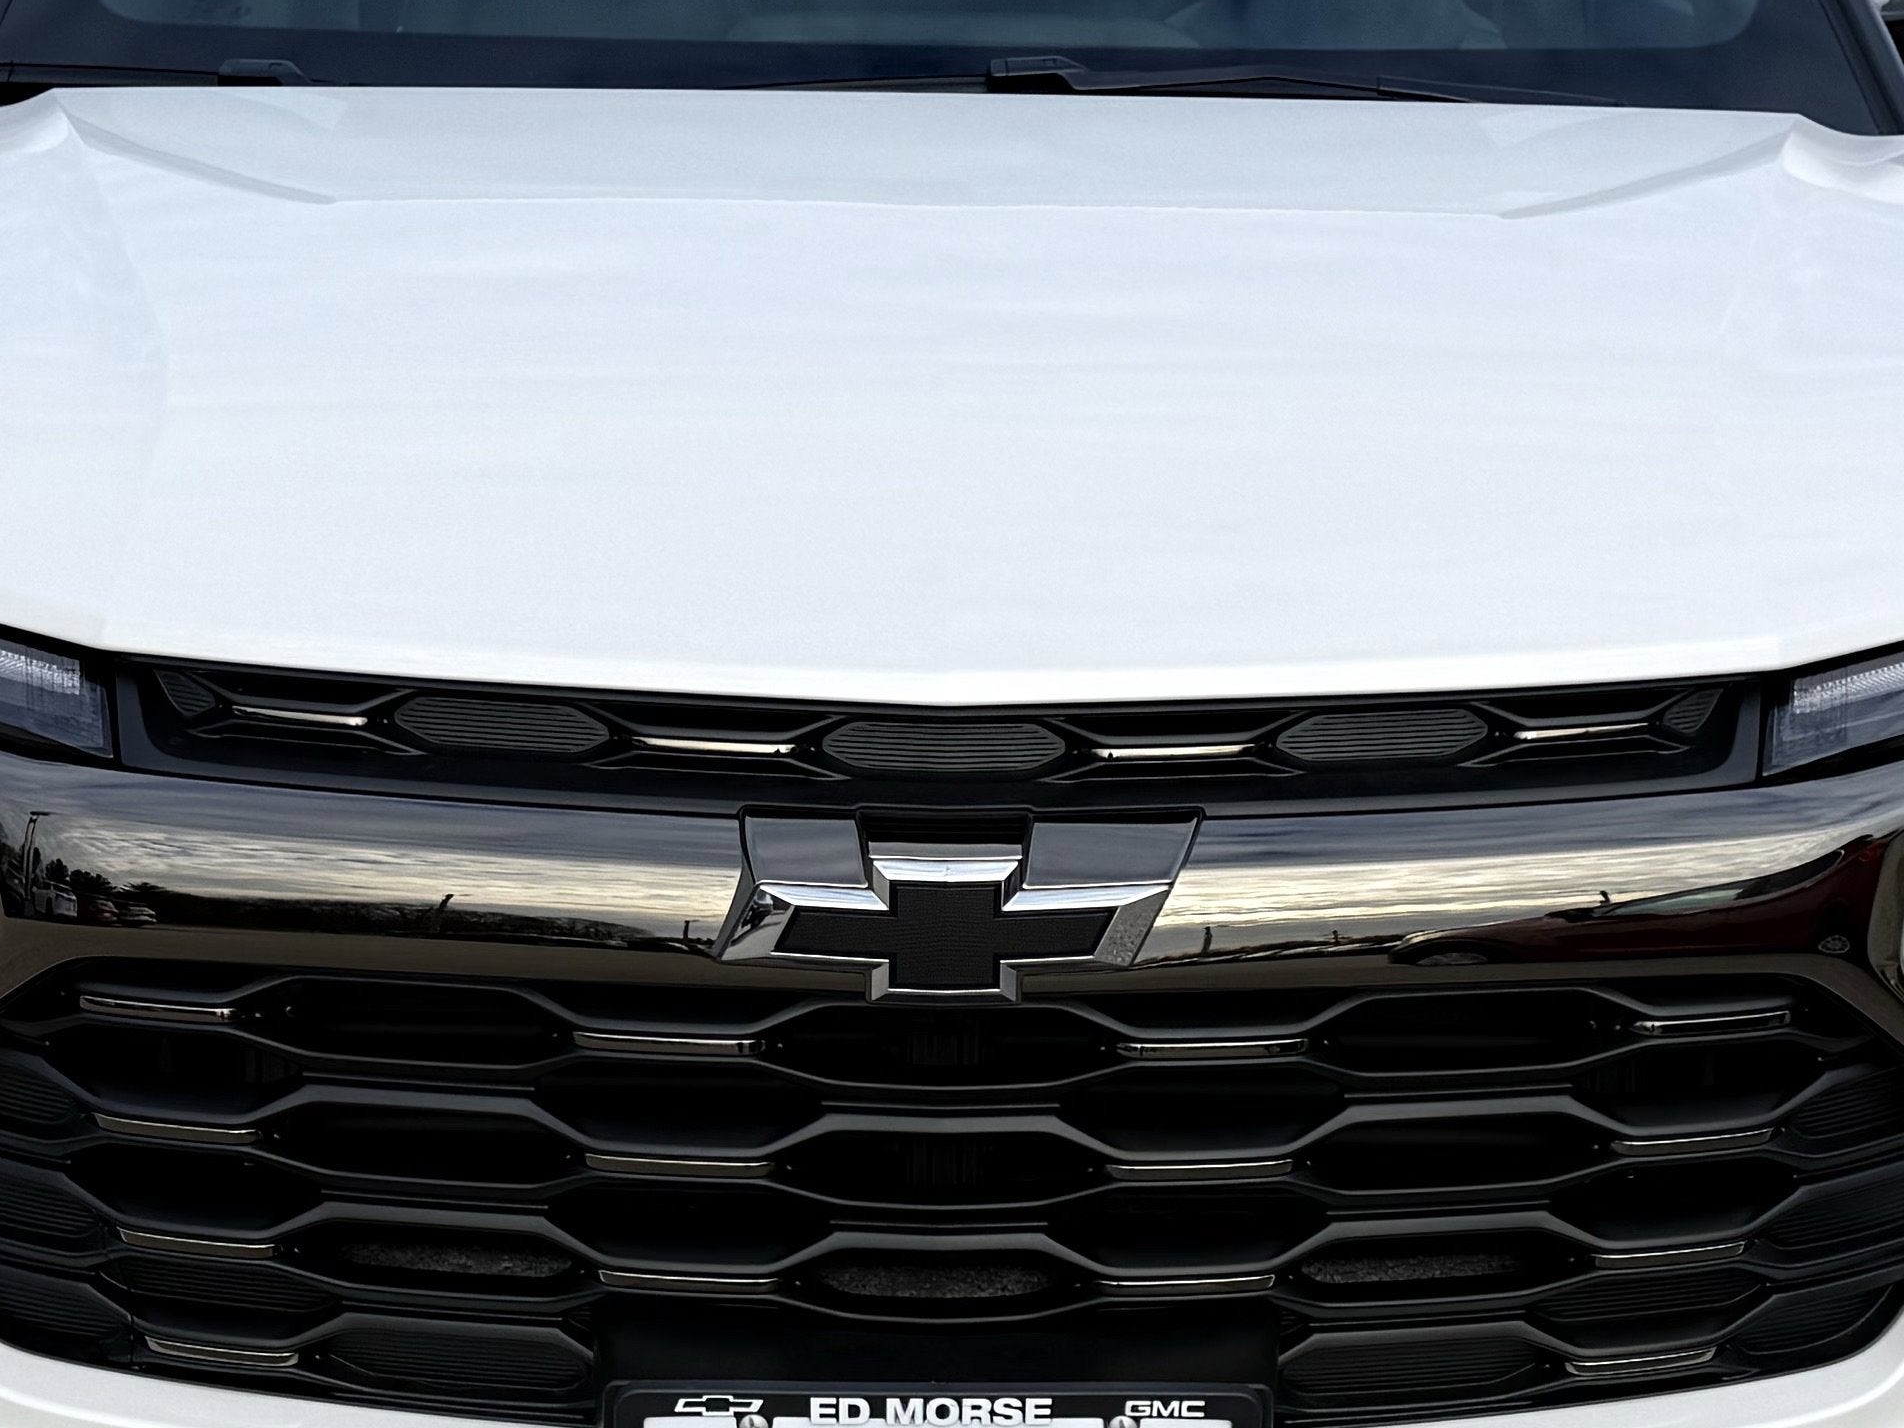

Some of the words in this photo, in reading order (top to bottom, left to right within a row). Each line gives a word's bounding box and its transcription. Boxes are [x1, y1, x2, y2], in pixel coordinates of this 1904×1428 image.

[809, 1397, 871, 1425] ED
[885, 1397, 1053, 1426] MORSE
[1124, 1400, 1206, 1418] GMC
